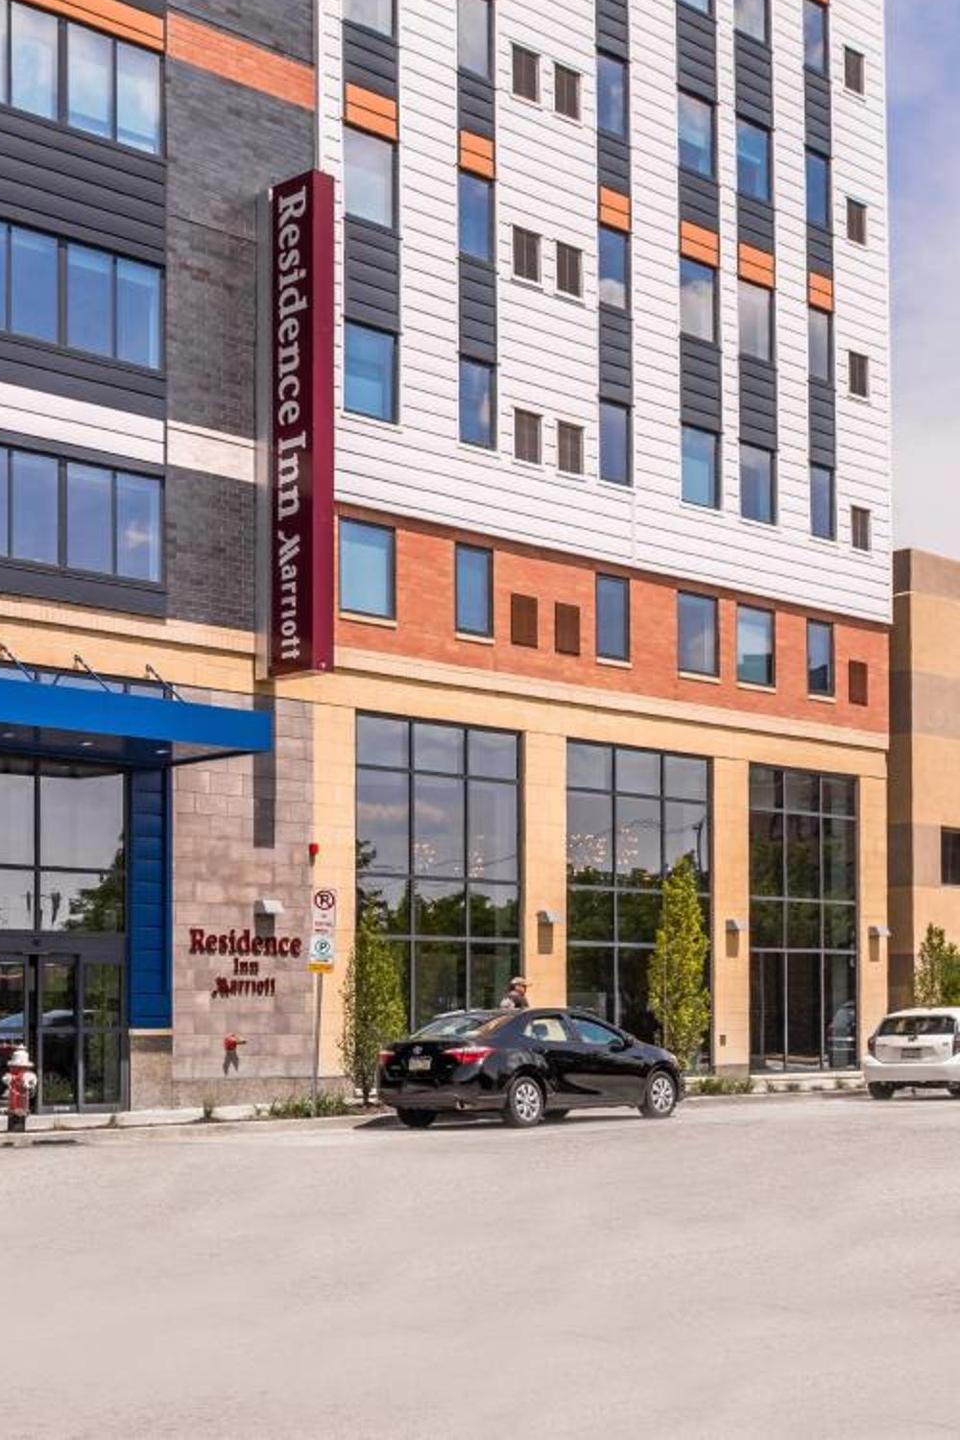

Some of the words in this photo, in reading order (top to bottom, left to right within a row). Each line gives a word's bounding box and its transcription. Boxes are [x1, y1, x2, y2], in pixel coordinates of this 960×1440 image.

[277, 185, 307, 426] Residence
[277, 433, 307, 521] Inn
[277, 531, 301, 660] Marriott
[189, 928, 302, 958] Residence
[233, 958, 259, 976] Inn
[211, 978, 276, 999] Marriott
